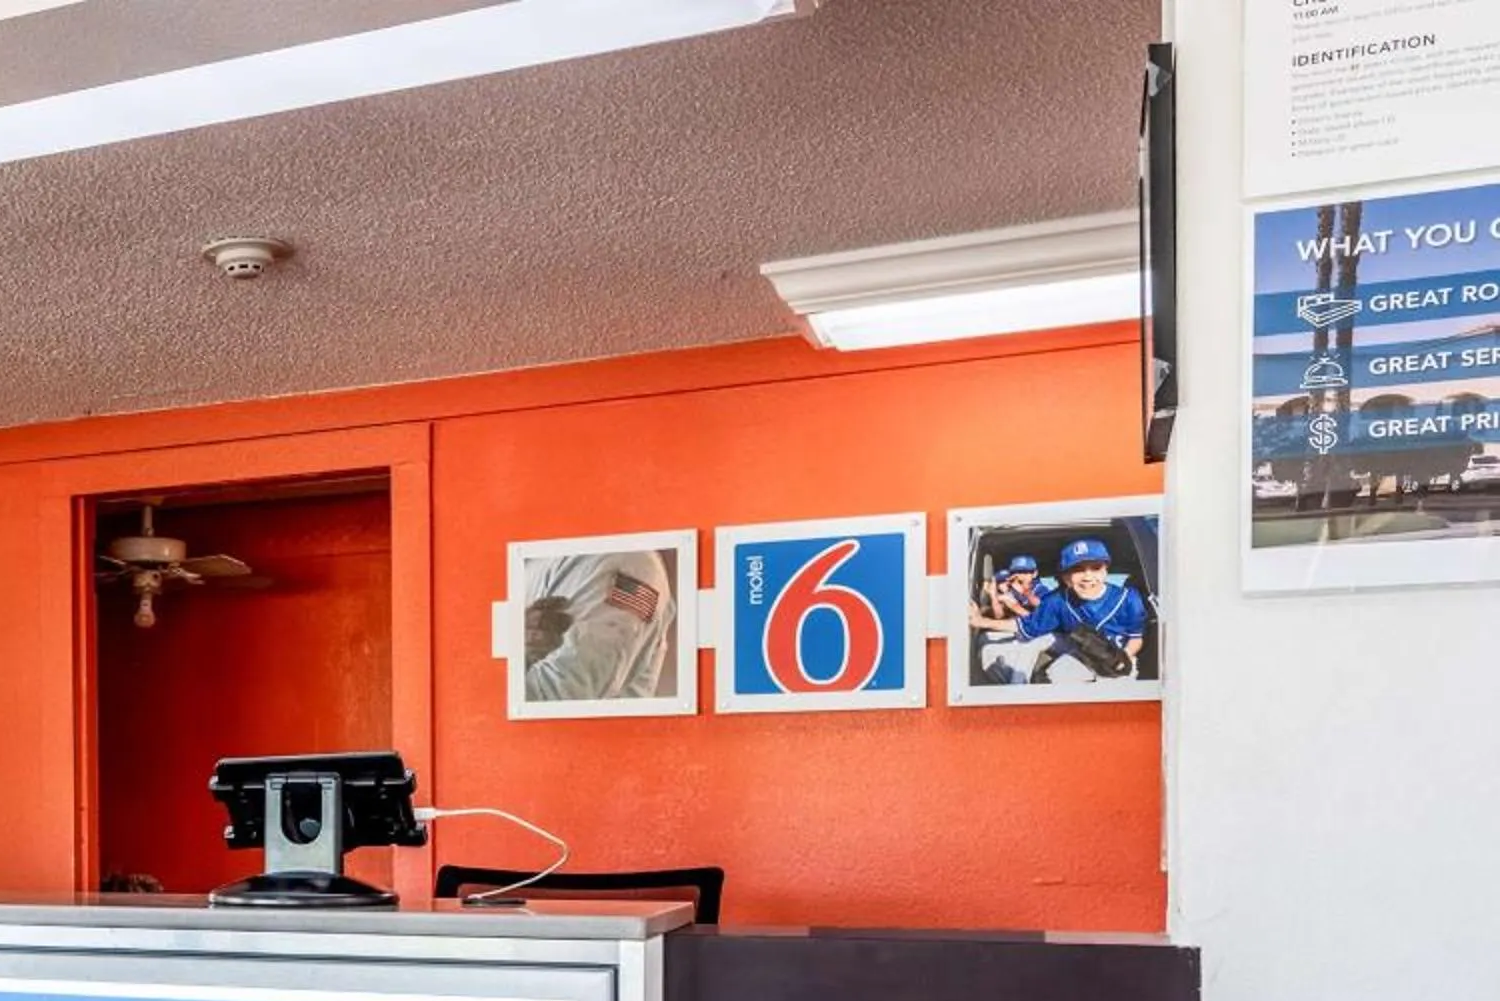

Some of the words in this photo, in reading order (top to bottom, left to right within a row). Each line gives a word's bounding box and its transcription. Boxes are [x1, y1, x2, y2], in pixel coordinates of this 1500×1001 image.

[1292, 34, 1436, 67] IDENTIFICATION
[1296, 229, 1393, 262] WHAT
[1404, 219, 1476, 250] YOU
[1369, 287, 1453, 312] GREAT
[1461, 282, 1499, 303] RO
[1369, 351, 1453, 375] GREAT
[1368, 415, 1451, 438] GREAT
[1460, 411, 1499, 431] PRI
[745, 555, 764, 605] motel
[762, 539, 884, 694] 6
